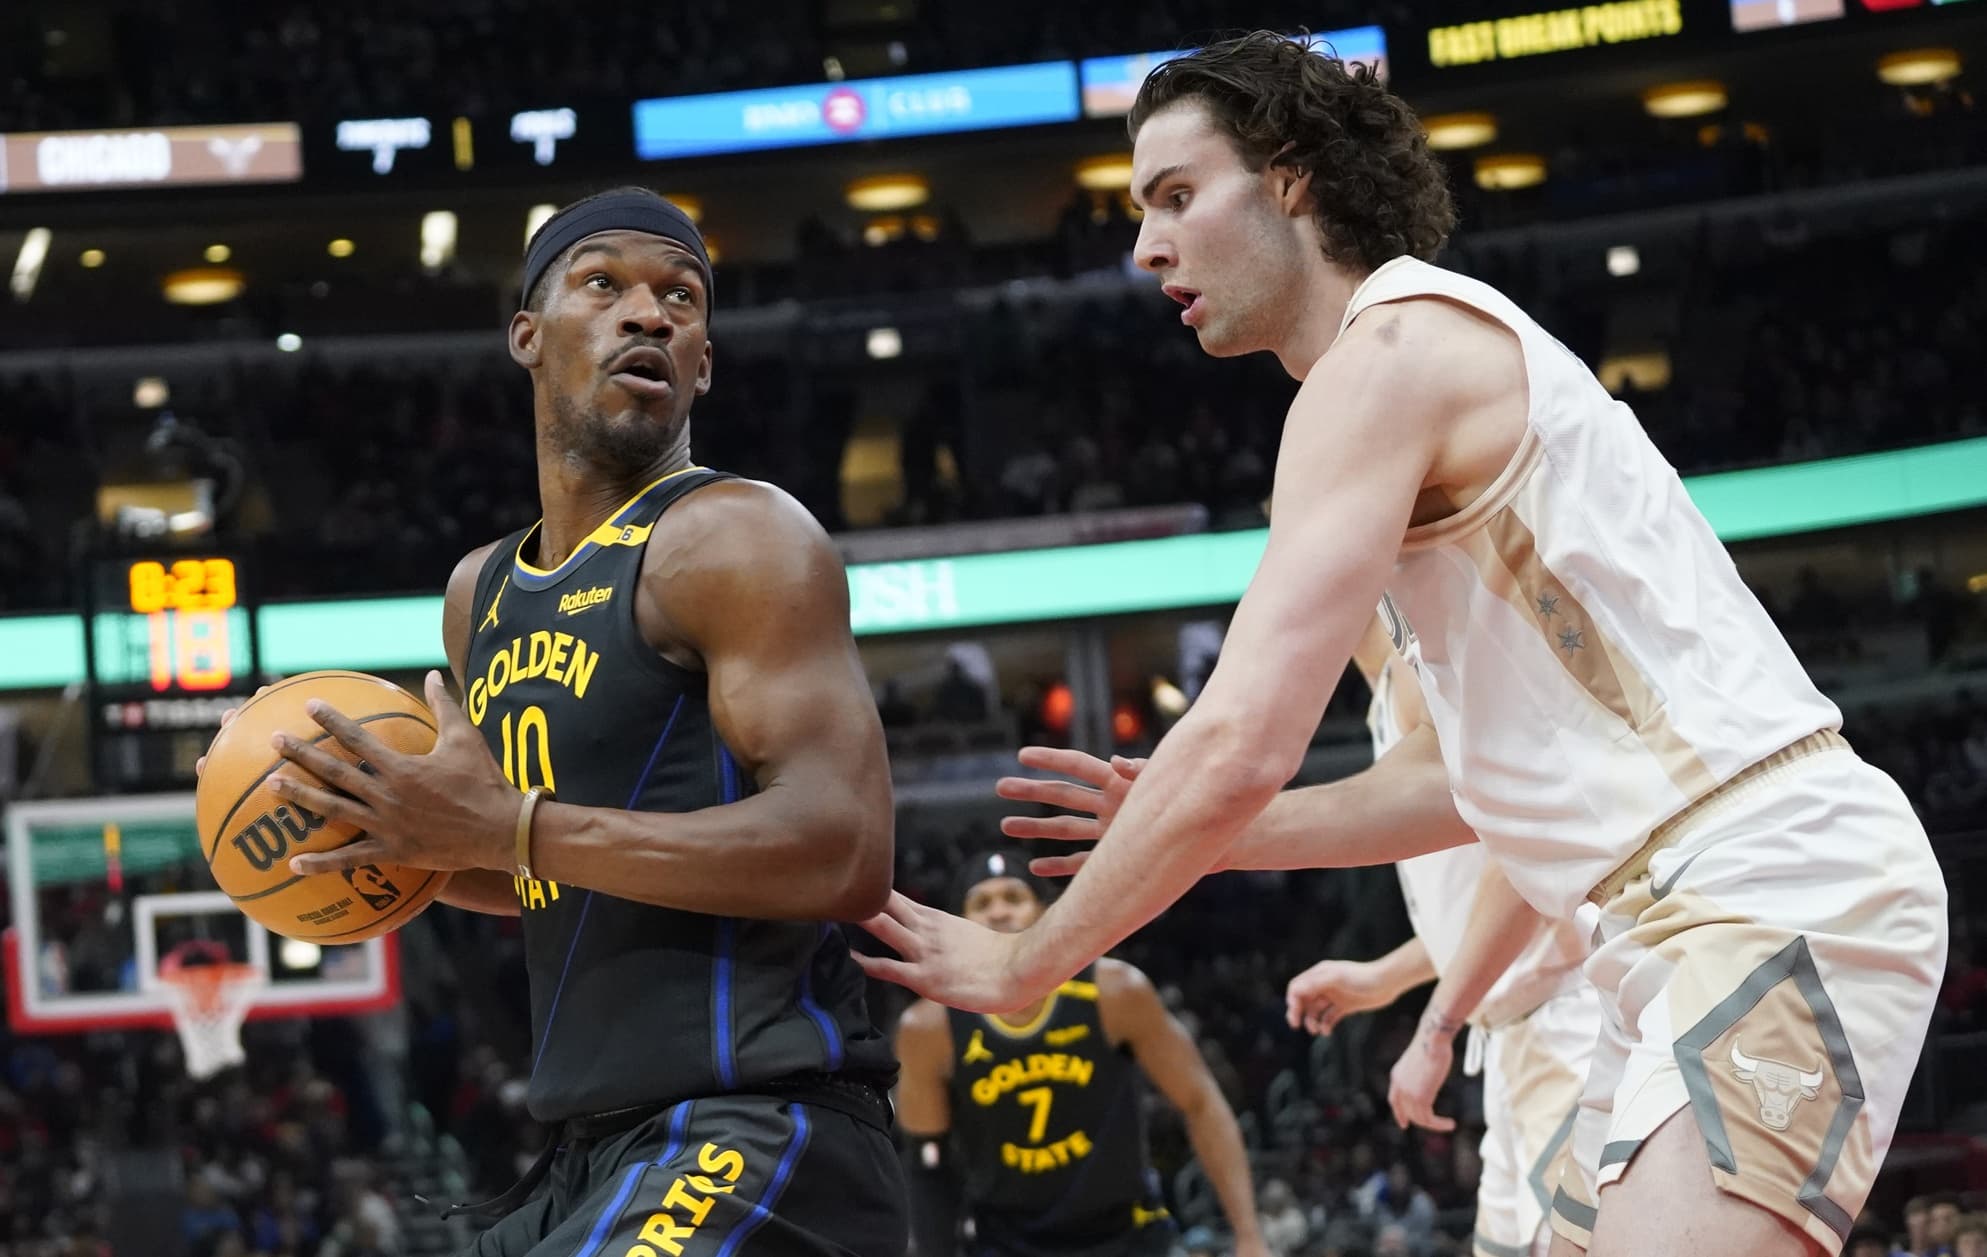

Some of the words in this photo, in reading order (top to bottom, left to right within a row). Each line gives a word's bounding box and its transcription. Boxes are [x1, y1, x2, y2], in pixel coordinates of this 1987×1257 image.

[1428, 21, 1496, 67] FAST
[1496, 8, 1598, 58] BREAK
[1598, 0, 1682, 43] POINTS
[558, 586, 613, 614] Rakuten
[149, 608, 232, 691] 18
[469, 630, 600, 726] GOLDEN
[502, 705, 556, 795] 10
[231, 801, 327, 871] Wil
[971, 1054, 1094, 1106] GOLDEN
[1018, 1086, 1053, 1144] 7
[1002, 1130, 1093, 1173] STATE
